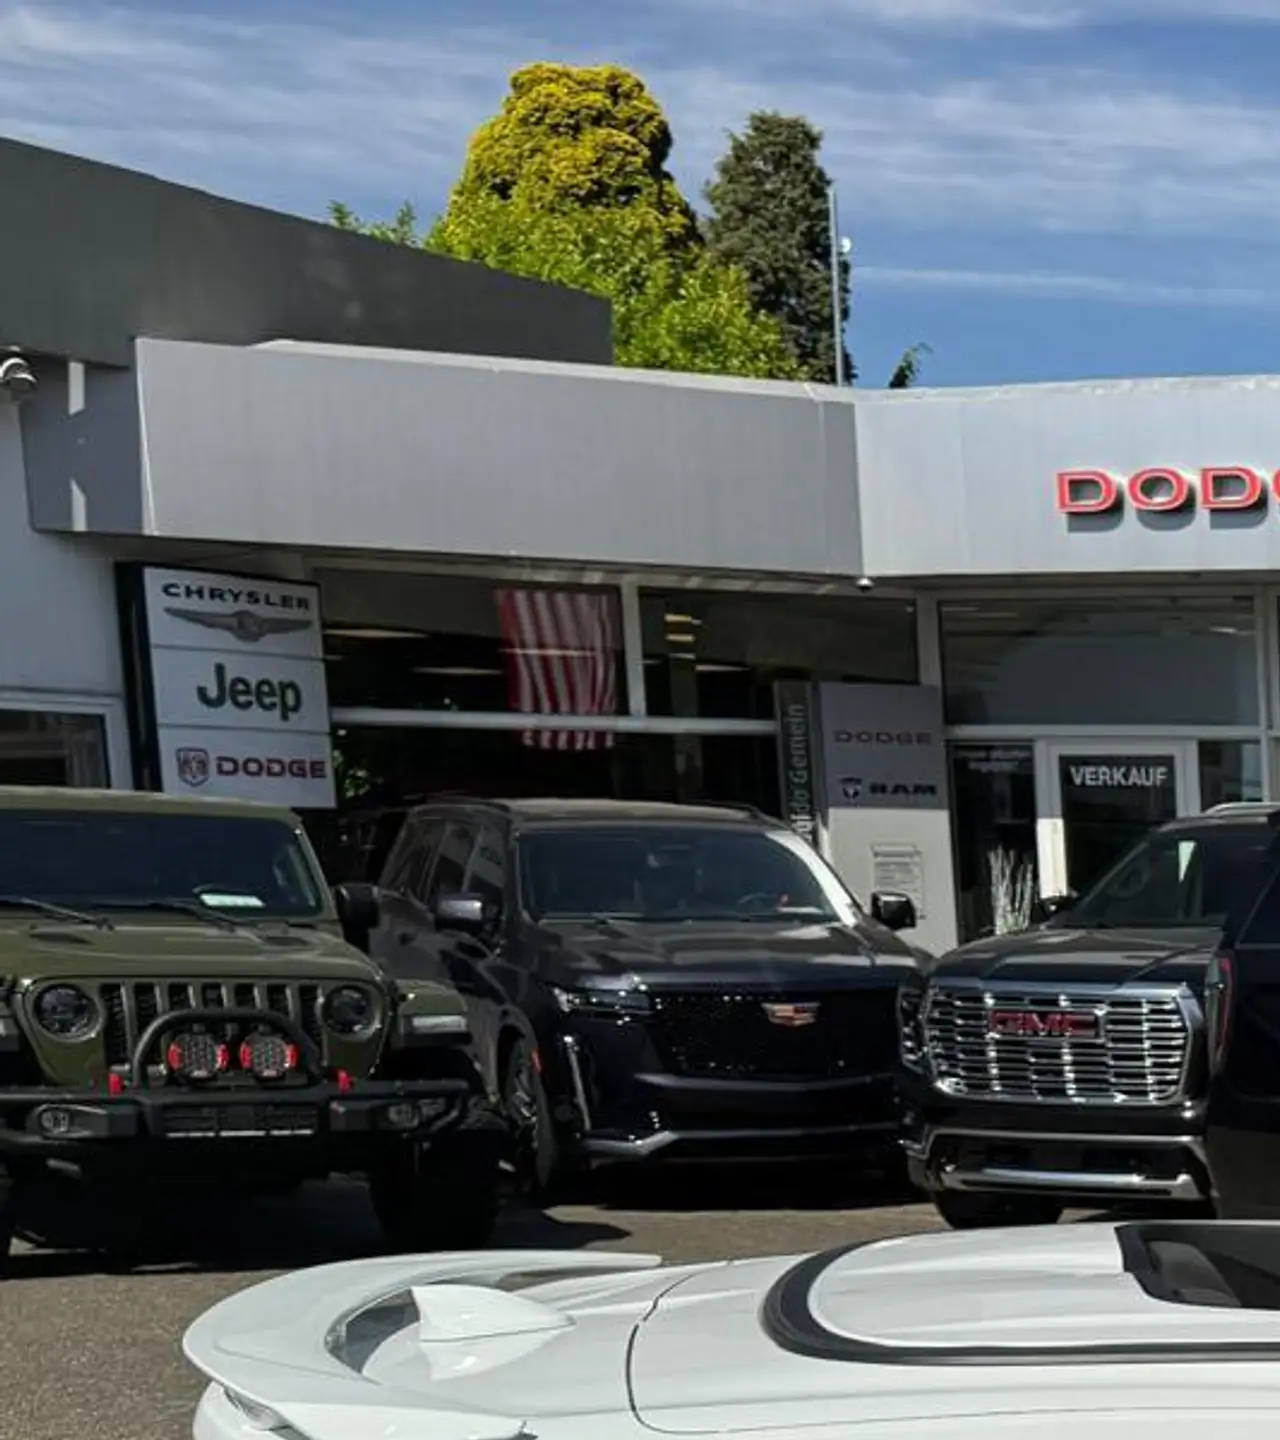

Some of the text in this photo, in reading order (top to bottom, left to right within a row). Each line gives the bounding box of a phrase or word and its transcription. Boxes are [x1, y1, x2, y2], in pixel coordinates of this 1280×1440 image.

[162, 583, 309, 610] CHRYSLER
[197, 663, 302, 721] Jeep
[834, 730, 932, 746] DODGE
[216, 756, 327, 778] DODGE
[1070, 766, 1168, 787] VERKAUF
[869, 782, 937, 797] RAM
[991, 1010, 1096, 1036] GMC
